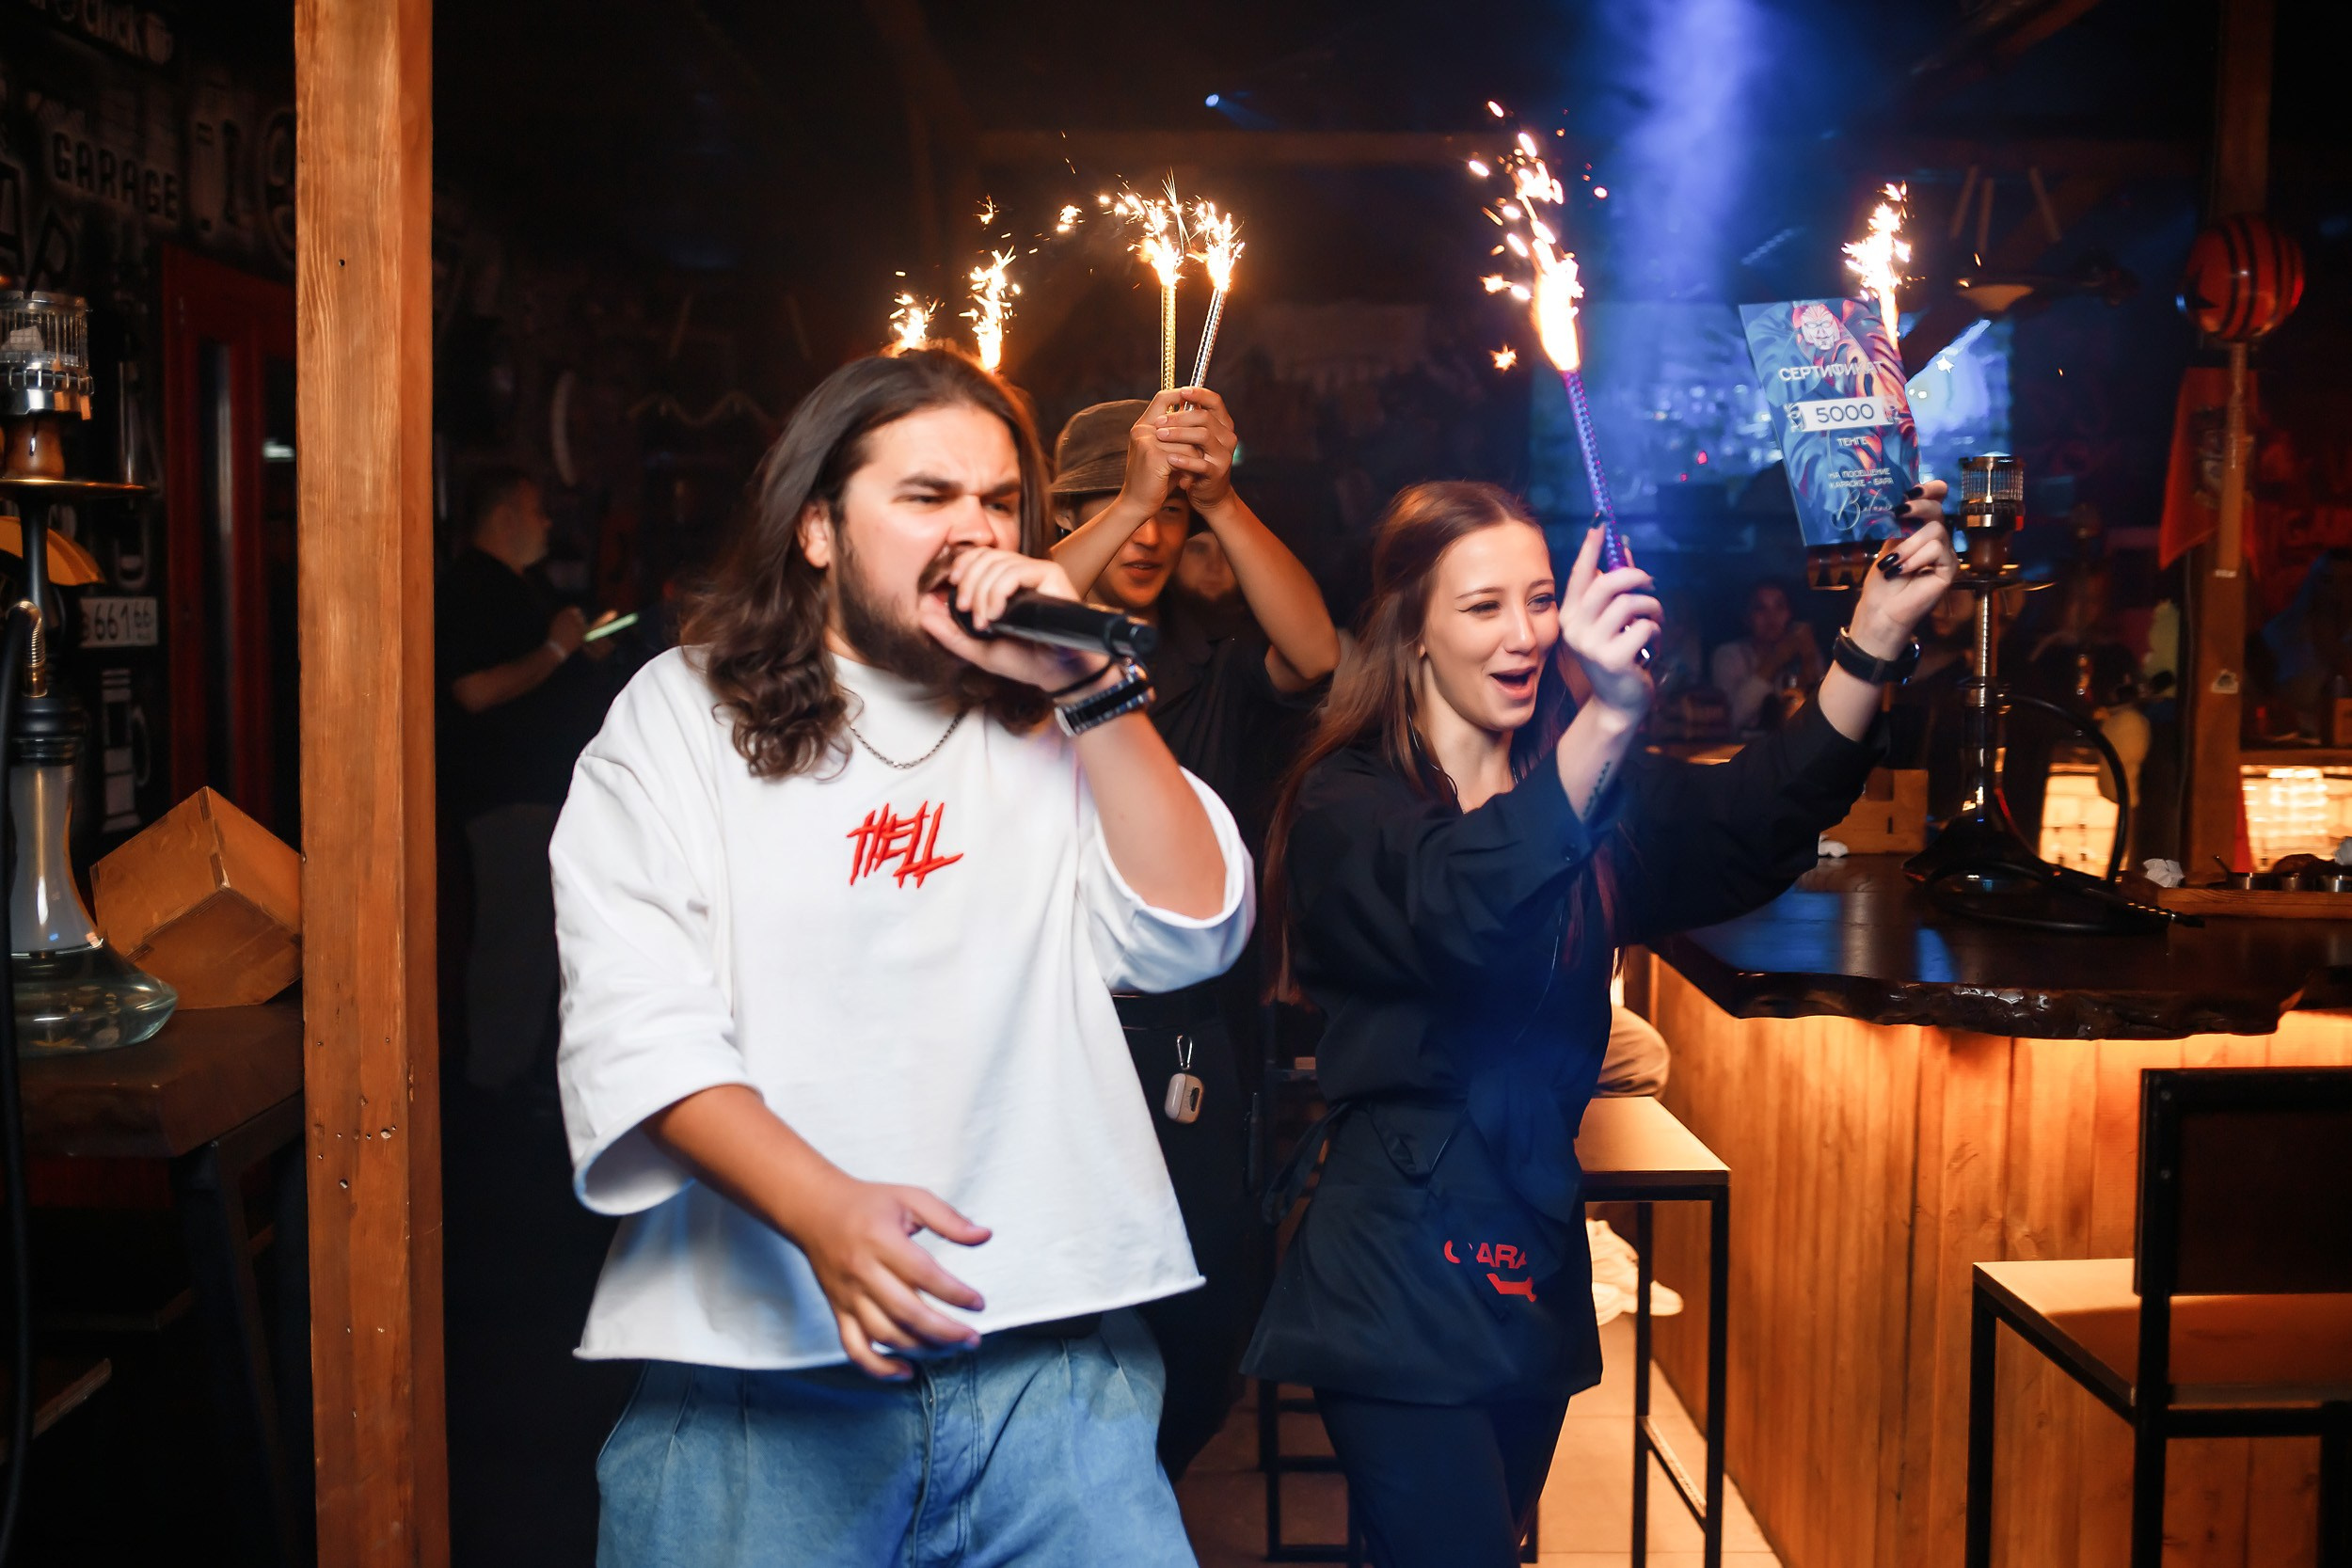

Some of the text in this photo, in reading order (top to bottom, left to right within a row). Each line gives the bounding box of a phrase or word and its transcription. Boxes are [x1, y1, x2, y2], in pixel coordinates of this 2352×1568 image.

[51, 130, 179, 224] GARAGE
[1778, 360, 1883, 382] СЕРТИФИКАТ
[1815, 403, 1875, 424] 5000
